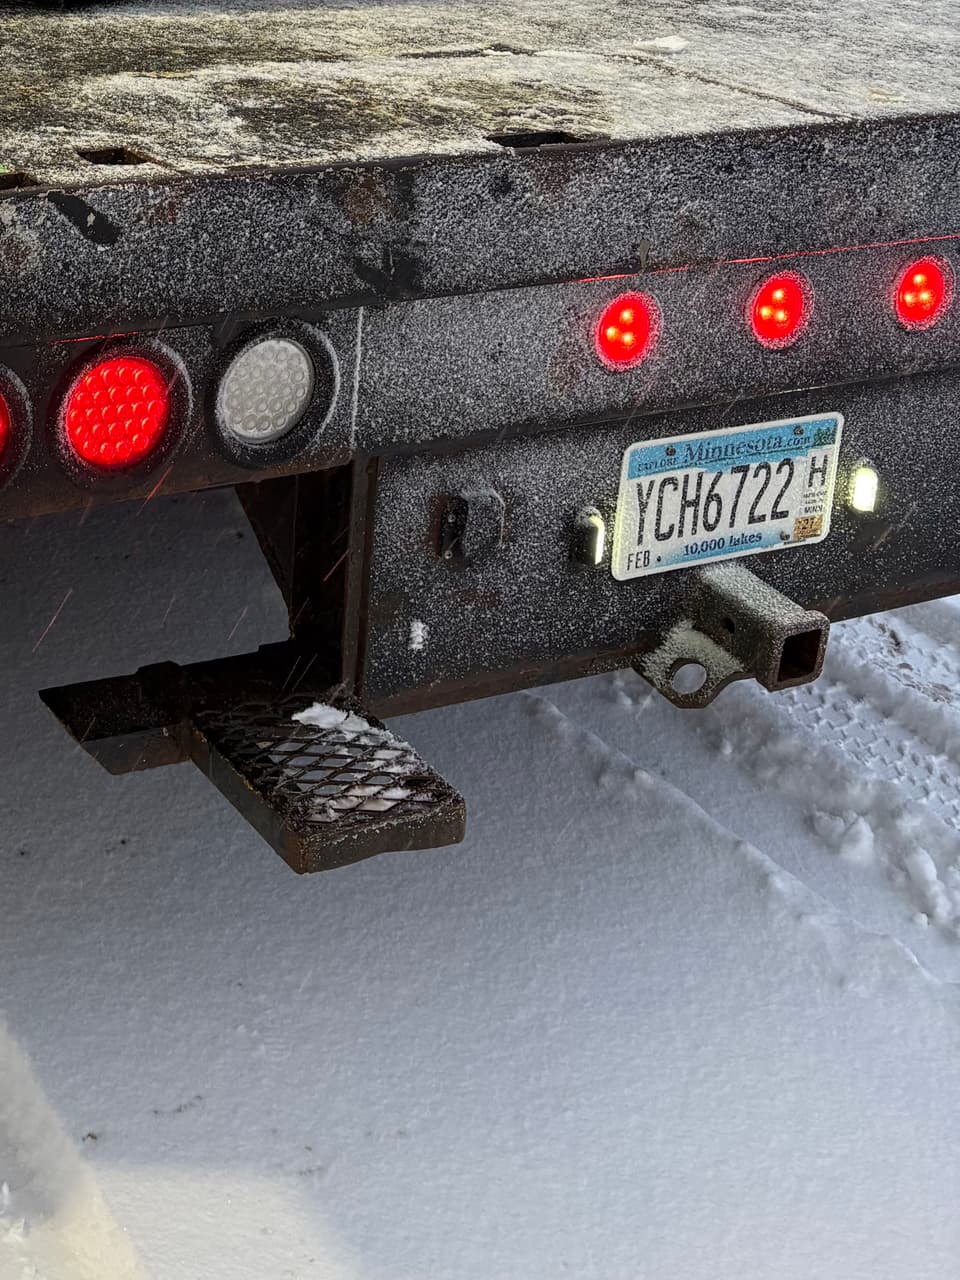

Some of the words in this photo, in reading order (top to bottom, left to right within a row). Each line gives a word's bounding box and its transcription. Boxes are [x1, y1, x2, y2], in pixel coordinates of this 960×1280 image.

[807, 454, 830, 488] H
[635, 457, 796, 546] YCH6722
[683, 537, 726, 557] 10,000
[728, 531, 762, 549] lakes
[626, 550, 651, 571] FEB
